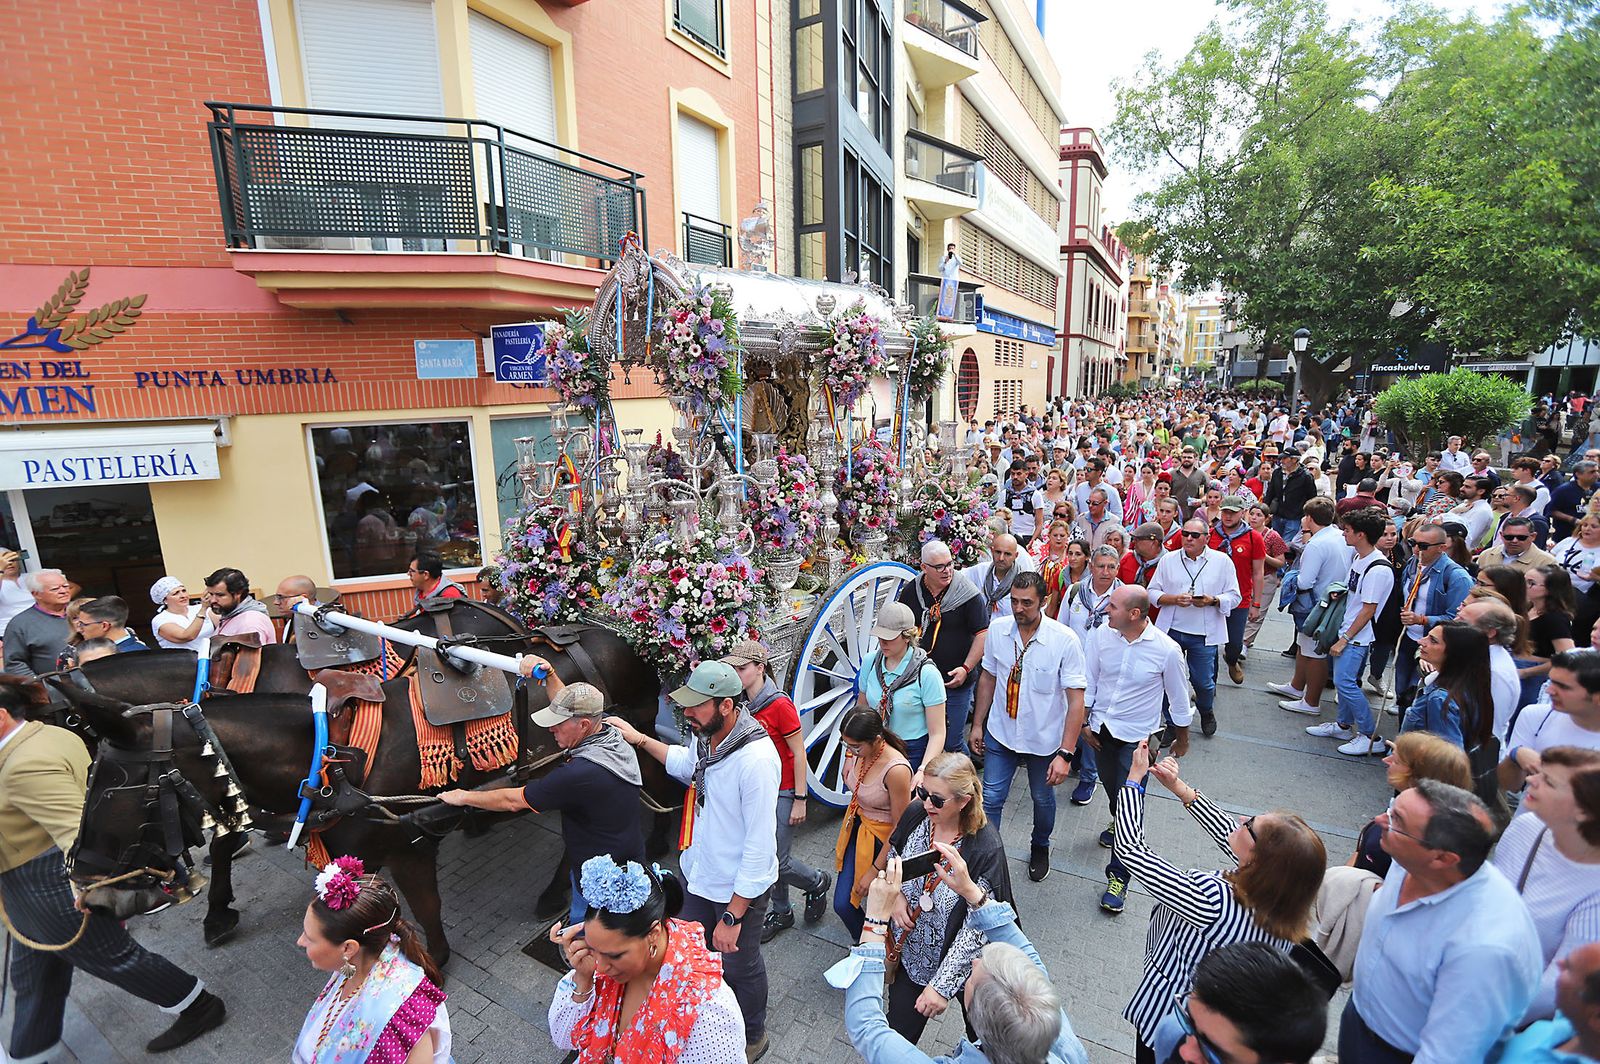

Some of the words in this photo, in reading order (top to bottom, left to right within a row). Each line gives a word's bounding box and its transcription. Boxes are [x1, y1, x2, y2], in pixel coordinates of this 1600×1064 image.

[39, 361, 91, 378] DEL
[419, 358, 441, 368] SANTA
[1371, 363, 1430, 371] Fincashuelva
[134, 370, 226, 388] PUNTA
[235, 368, 338, 385] UMBRIA
[22, 448, 199, 483] PASTELERÍA
